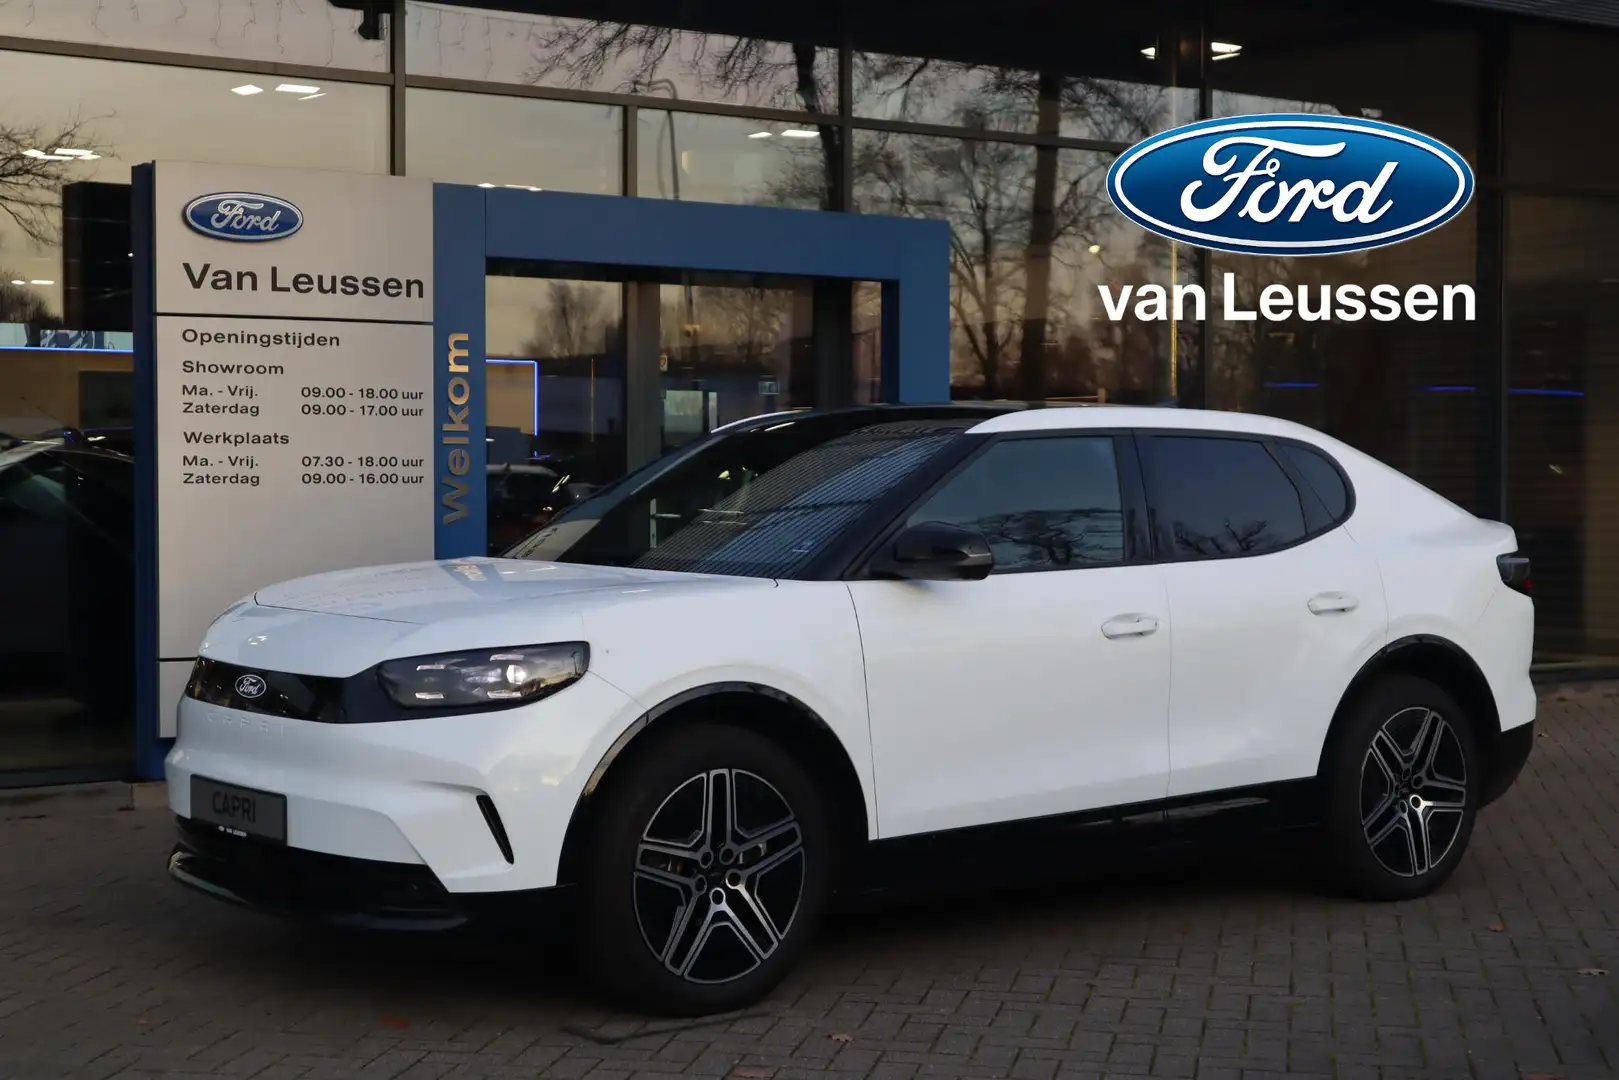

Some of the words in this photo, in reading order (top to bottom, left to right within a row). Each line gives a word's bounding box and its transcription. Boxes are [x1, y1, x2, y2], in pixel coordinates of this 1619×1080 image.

[210, 199, 282, 233] Ford
[182, 262, 258, 292] Van
[270, 266, 425, 299] Leussen
[182, 328, 340, 348] Openingstijden
[182, 360, 284, 375] Showroom
[182, 384, 213, 396] Ma.
[227, 385, 259, 399] Vrij.
[301, 386, 346, 399] 09.00
[358, 387, 399, 400] 18.00
[401, 391, 424, 400] uur
[182, 402, 260, 417] Zaterdag
[301, 403, 347, 416] 09.00
[359, 405, 398, 416] 17.00
[401, 407, 424, 417] uur
[442, 332, 471, 526] Welkom
[183, 431, 290, 447] Werkplaats
[182, 455, 214, 467] Ma.
[227, 455, 259, 469] Vrij.
[301, 456, 345, 468] 07.30
[357, 456, 398, 468] 18.00
[401, 458, 425, 467] uur
[182, 473, 260, 487] Zaterdag
[301, 473, 347, 485] 09.00
[358, 473, 399, 485] 16.00
[401, 475, 425, 484] uur
[212, 791, 256, 823] CAPRI
